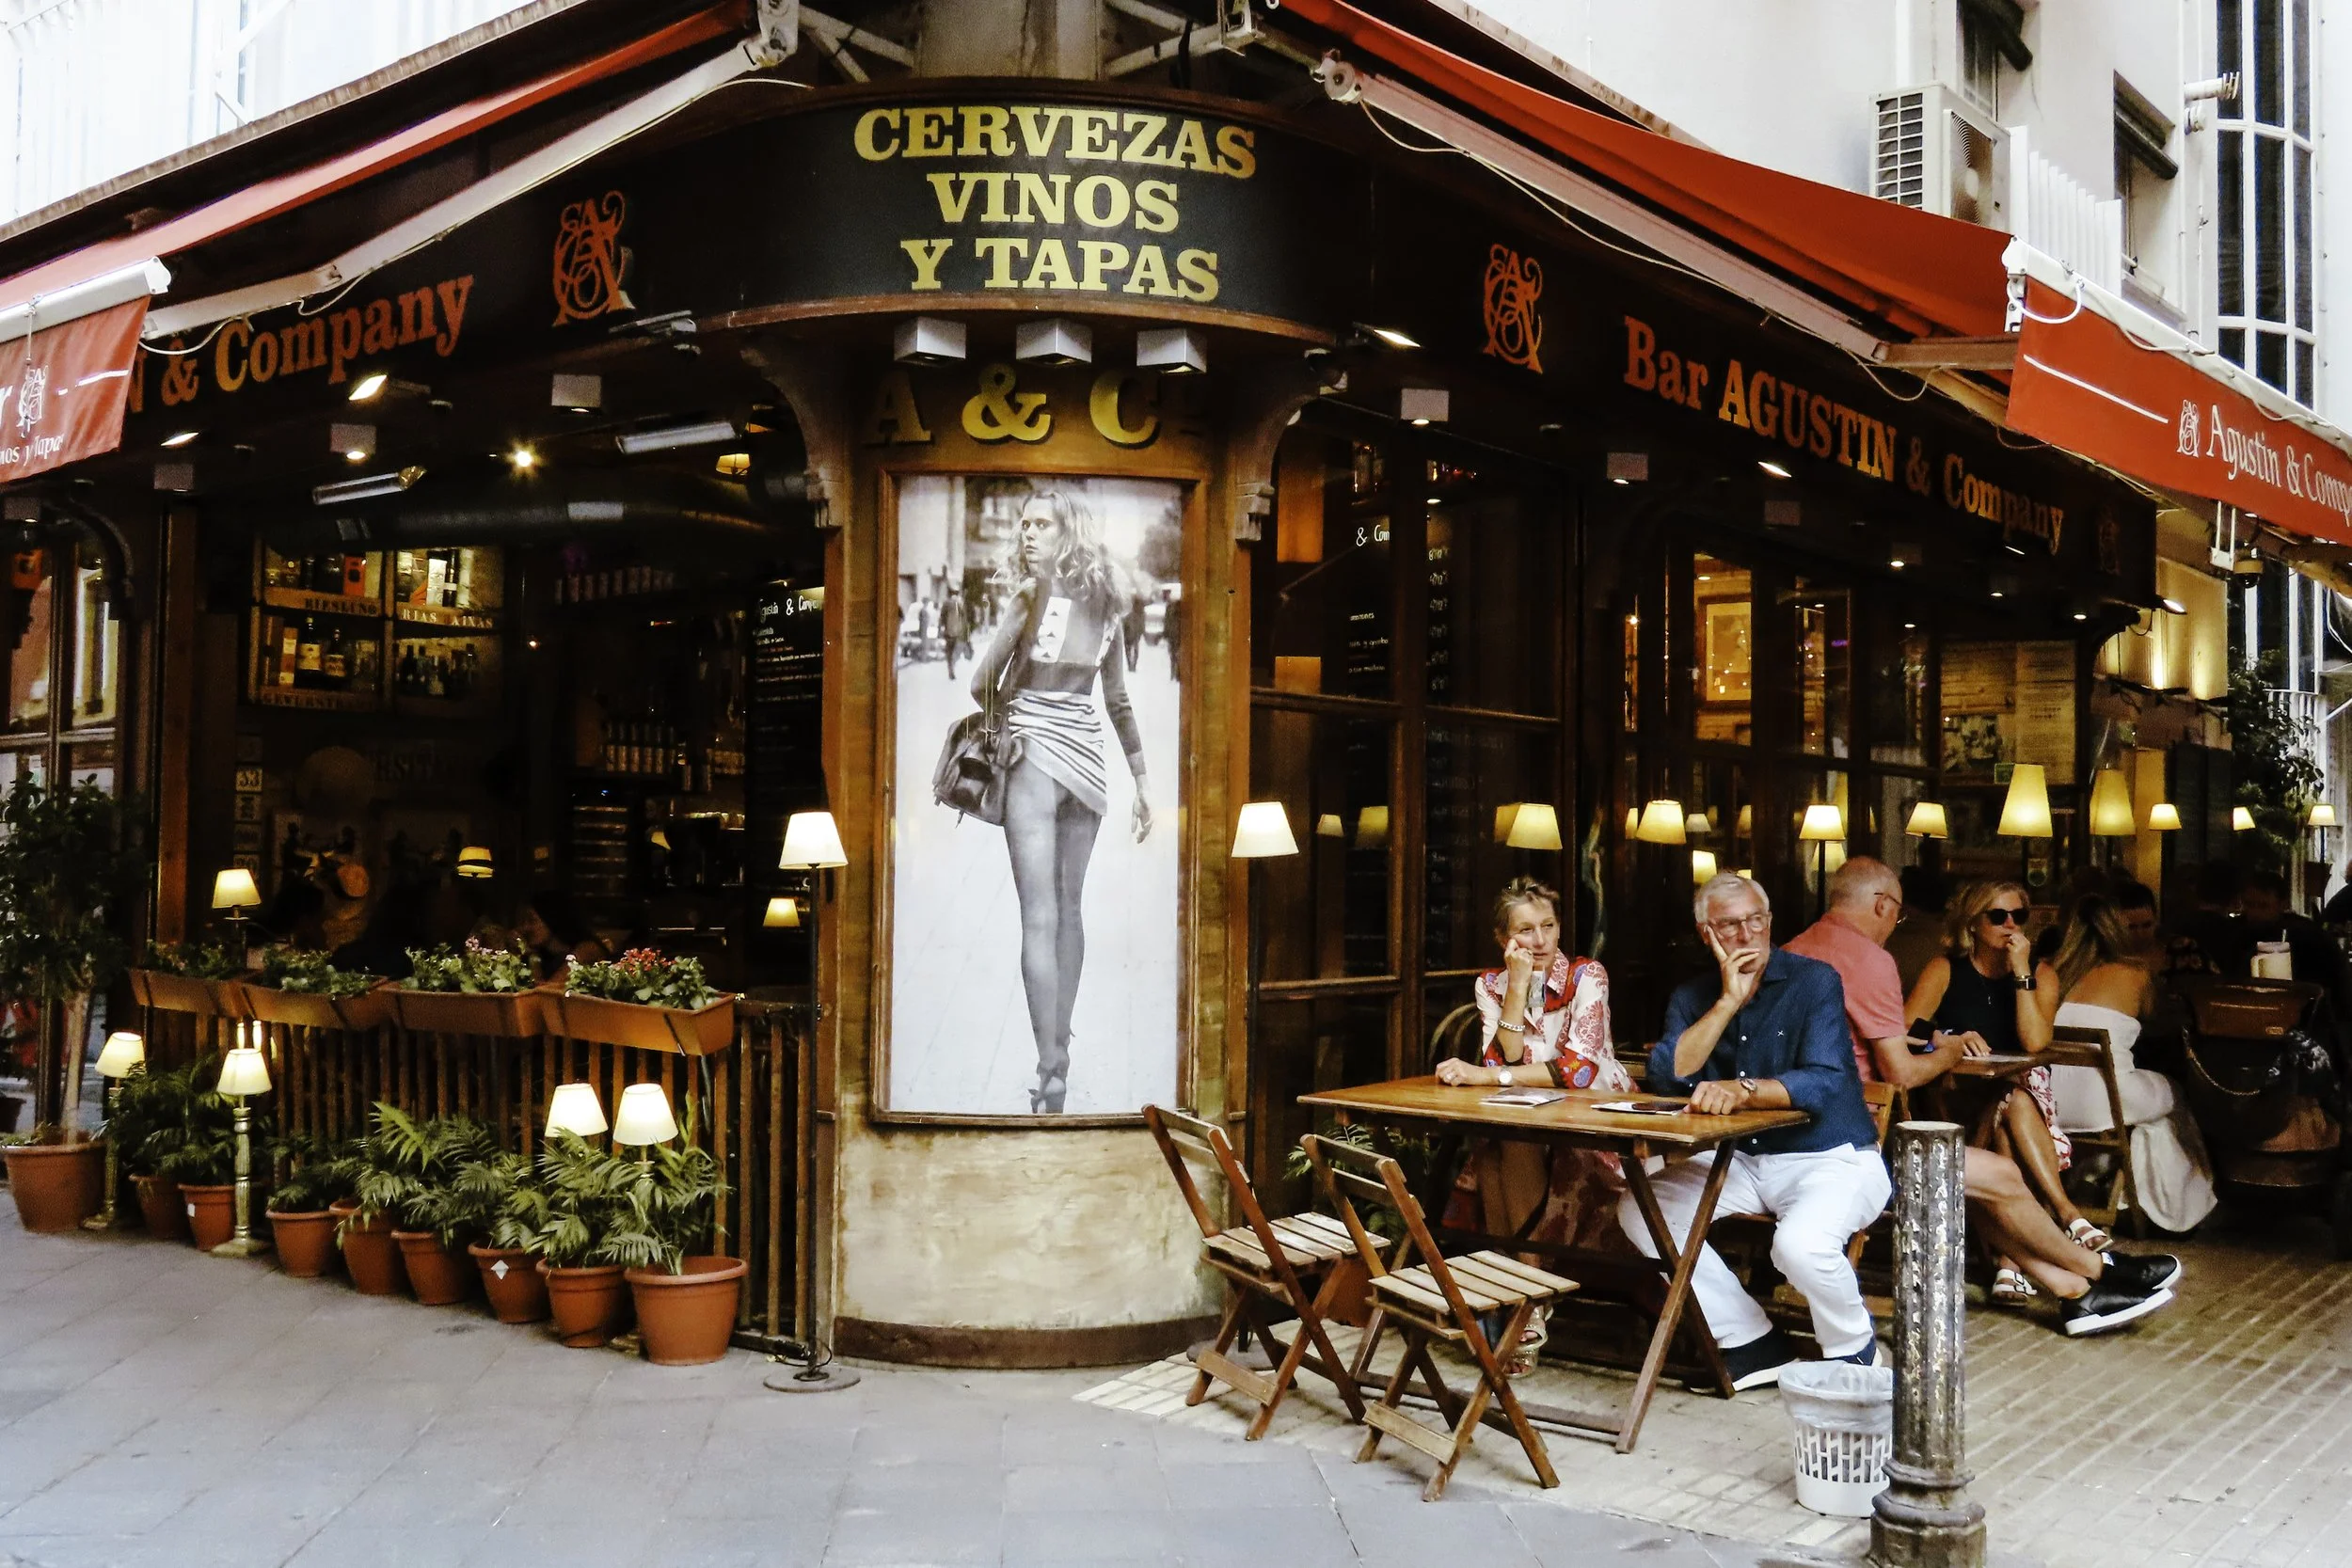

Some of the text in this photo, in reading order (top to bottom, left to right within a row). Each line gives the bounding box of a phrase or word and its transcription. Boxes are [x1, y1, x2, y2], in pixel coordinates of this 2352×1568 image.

[854, 105, 1257, 179] CERVEZAS
[927, 172, 1180, 233] VINOS
[900, 237, 1219, 302] Y TAPAS
[161, 338, 199, 406] &
[215, 275, 474, 392] Company
[866, 369, 932, 444] A
[961, 362, 1052, 442] &
[1624, 315, 1709, 410] Bar
[1718, 359, 1898, 482] AGUSTIN
[1906, 436, 1931, 497] &
[1944, 452, 2064, 556] Company
[2206, 404, 2282, 488] Agustin
[2286, 445, 2304, 498] &
[2304, 453, 2352, 528] Comp
[786, 598, 795, 616] &
